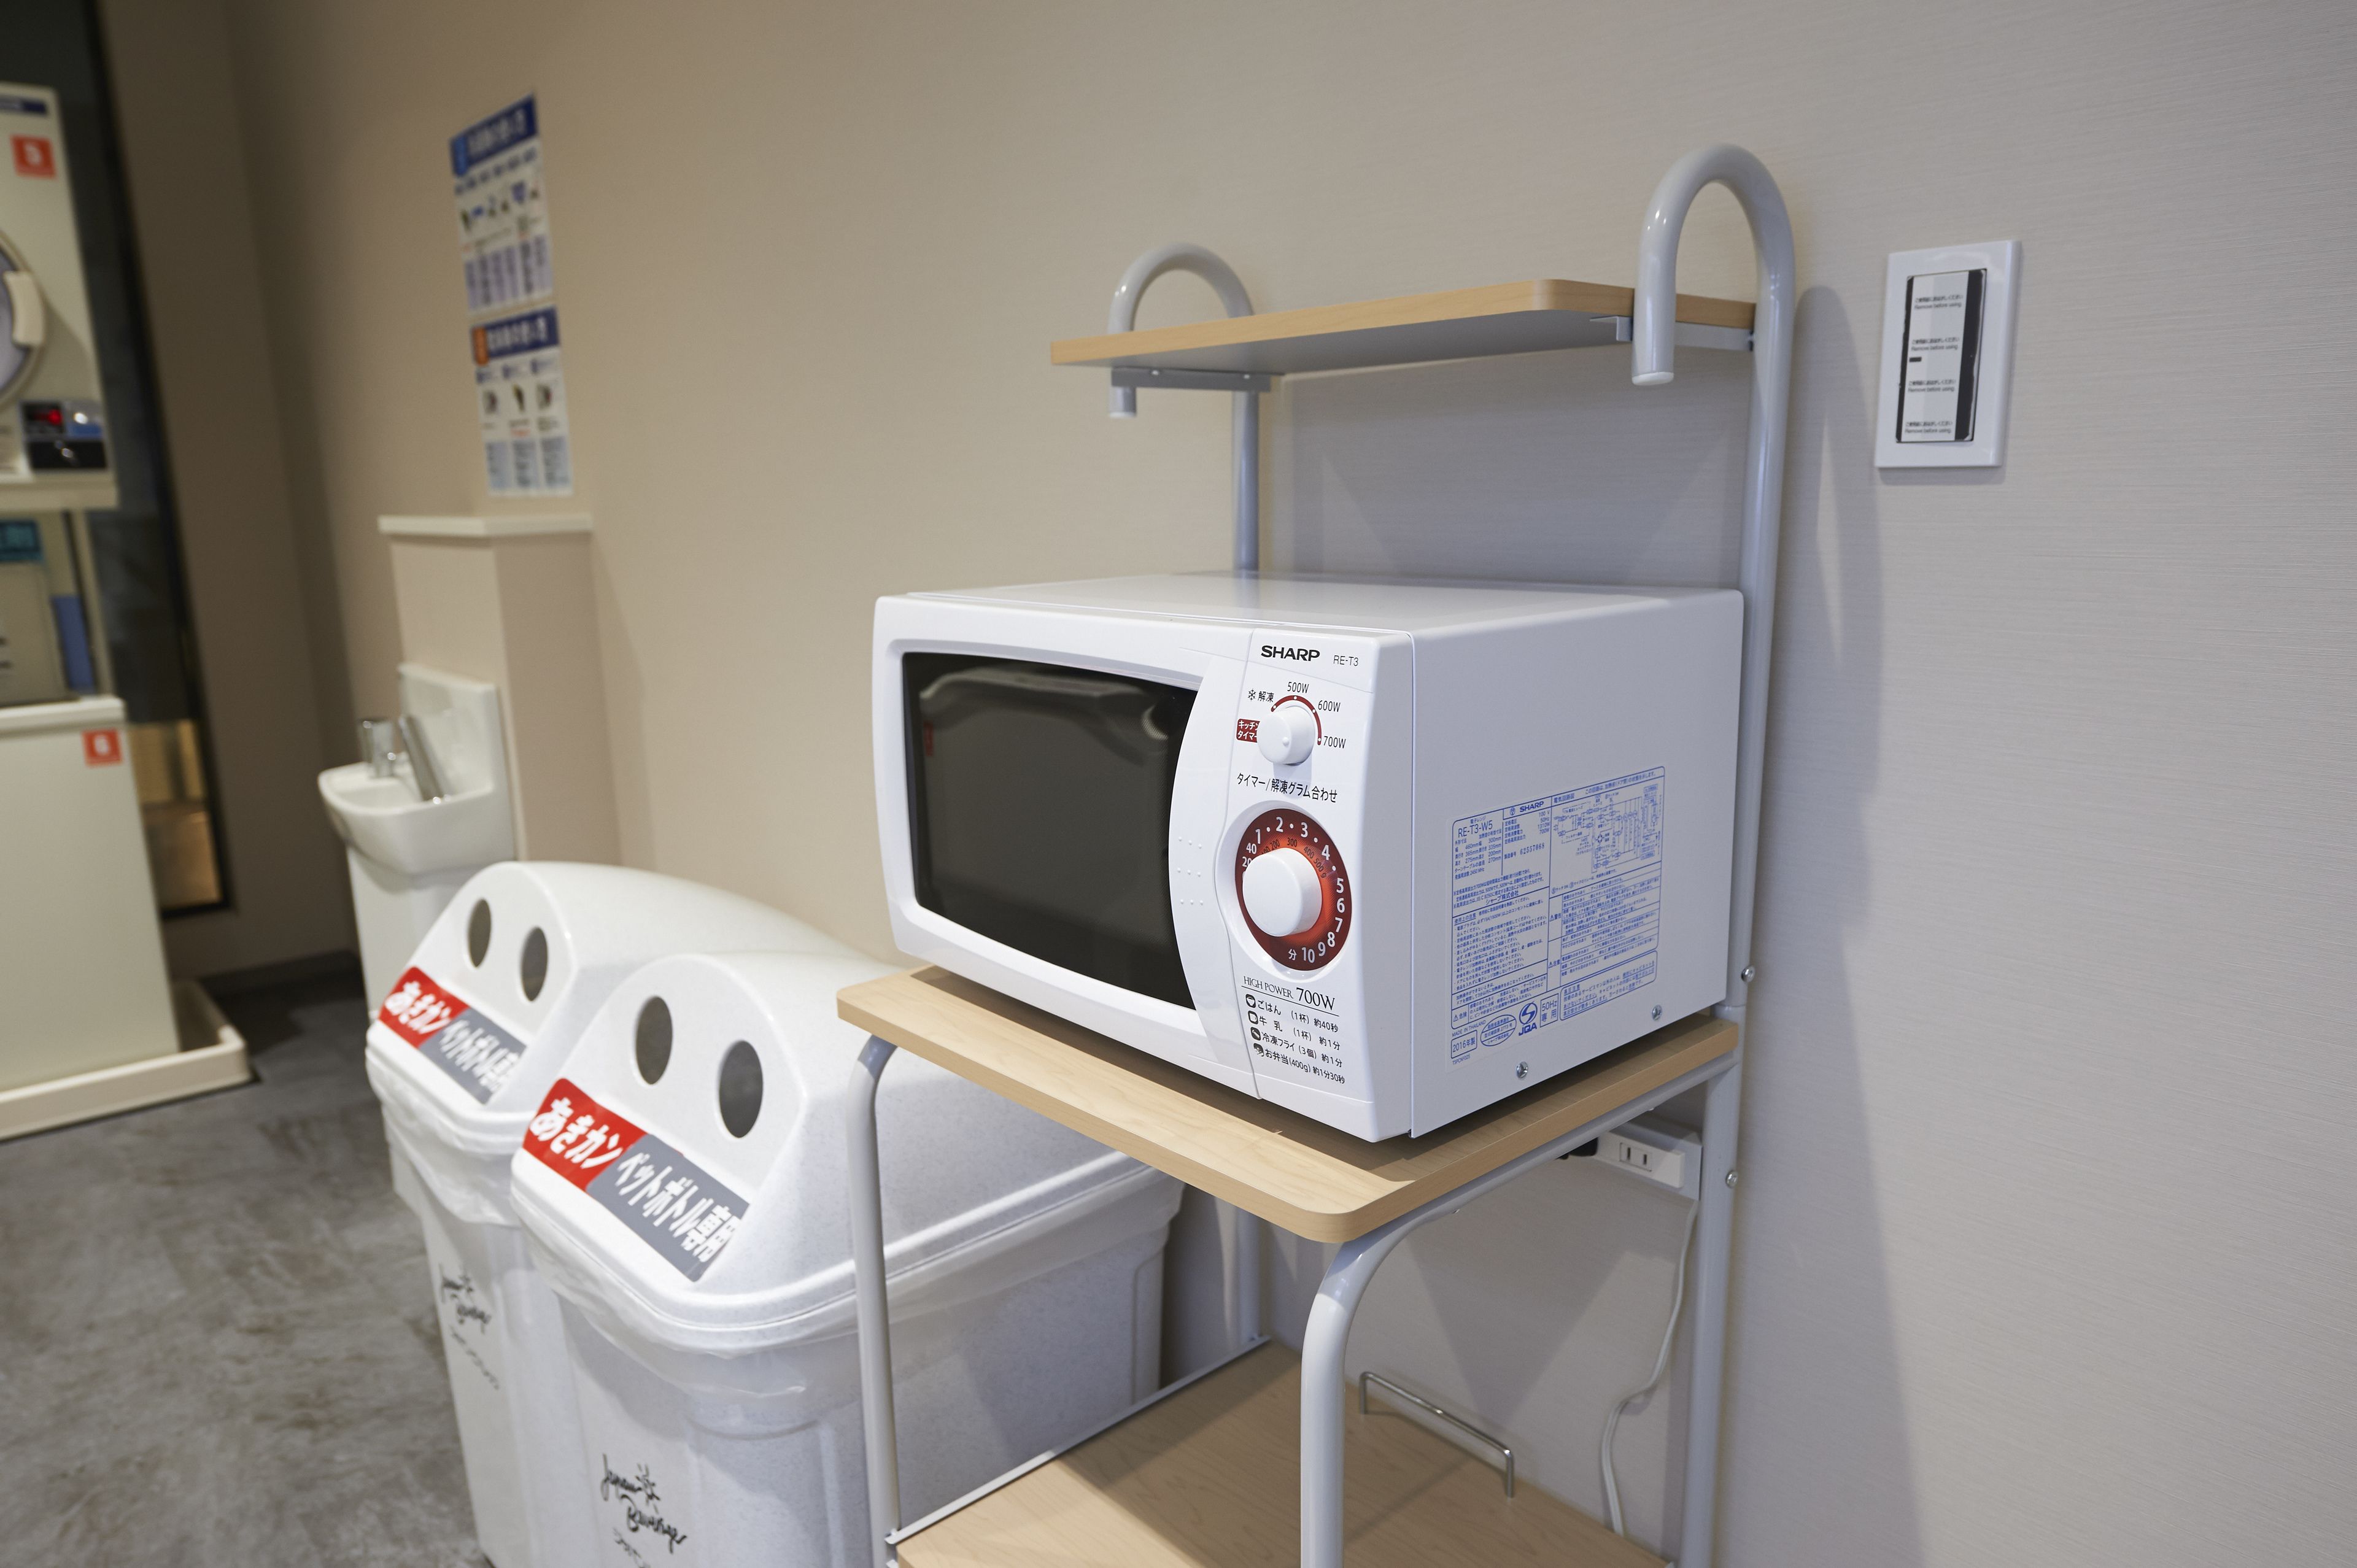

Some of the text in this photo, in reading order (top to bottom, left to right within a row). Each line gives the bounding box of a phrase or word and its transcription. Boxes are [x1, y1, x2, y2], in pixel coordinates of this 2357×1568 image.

[1261, 645, 1320, 661] SHARP
[1333, 655, 1359, 666] RE-T3
[1287, 682, 1309, 693] 500W
[1258, 691, 1274, 702] 解凍
[1318, 700, 1341, 713] 600W
[1323, 736, 1345, 749] 700W
[1520, 801, 1544, 813] SHARP
[1276, 817, 1283, 832] 2
[1301, 822, 1308, 837] 3
[1458, 820, 1493, 838] RE-T3-W5
[1256, 829, 1261, 844] 1
[1246, 843, 1256, 854] 40
[1287, 838, 1298, 847] 300
[1303, 846, 1314, 859] 400
[1314, 858, 1323, 871] 500
[1322, 845, 1330, 860] 4
[1336, 878, 1344, 893] 5
[1485, 890, 1519, 905] シャープ株式会社
[1337, 898, 1345, 913] 6
[1335, 917, 1342, 933] 7
[1328, 932, 1335, 947] 8
[1288, 949, 1297, 960] 分
[1302, 947, 1315, 963] 10
[1318, 942, 1326, 956] 9
[1244, 976, 1335, 1010] HIGH POWER 700W
[385, 981, 451, 1033] あきカン
[1542, 1000, 1557, 1011] 50Hz
[1258, 1000, 1281, 1015] ごはん
[1314, 1018, 1338, 1033] 約40秒
[1519, 1022, 1537, 1036] JQA
[1261, 1032, 1295, 1051] 冷凍フライ
[1322, 1054, 1342, 1067] 約1分
[1320, 1037, 1340, 1051] 約1分
[1453, 1037, 1475, 1052] 2016年製
[529, 1098, 624, 1170] あきカン
